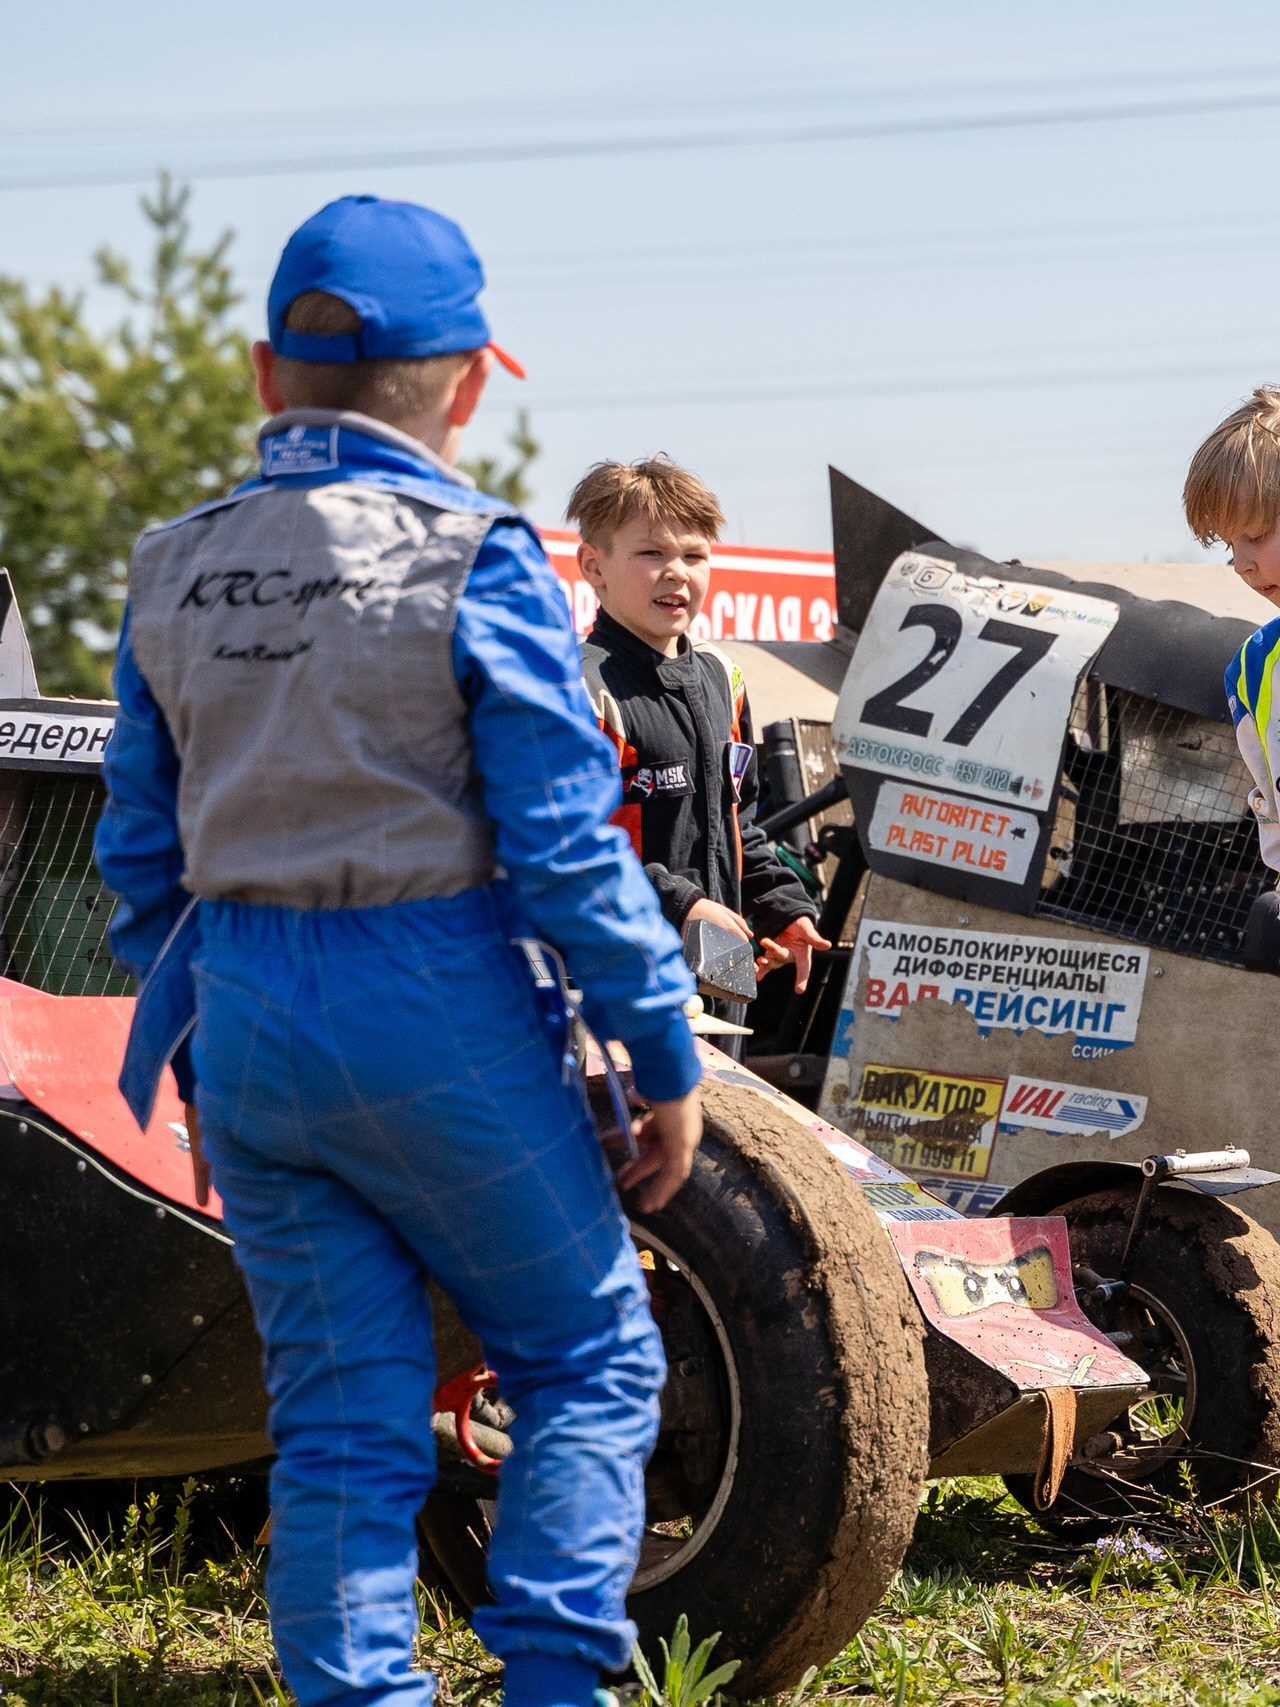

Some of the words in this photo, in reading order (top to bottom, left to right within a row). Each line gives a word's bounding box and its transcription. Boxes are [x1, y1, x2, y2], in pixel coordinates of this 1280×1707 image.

[859, 603, 1060, 747] 27
[656, 766, 686, 785] MSK
[847, 737, 944, 776] АВТОКРОСС
[954, 760, 981, 784] FEST
[885, 824, 949, 858] PLAST
[952, 839, 1008, 872] PLUS
[867, 930, 1141, 974] САМОБЛОКИРУЮЩИЕСЯ
[893, 956, 1105, 994] ДИФФЕРЕНЦИАЛЫ
[953, 987, 1126, 1033] РЕЙСИНГ
[1006, 1084, 1066, 1119] VAL
[1069, 1093, 1112, 1111] racing
